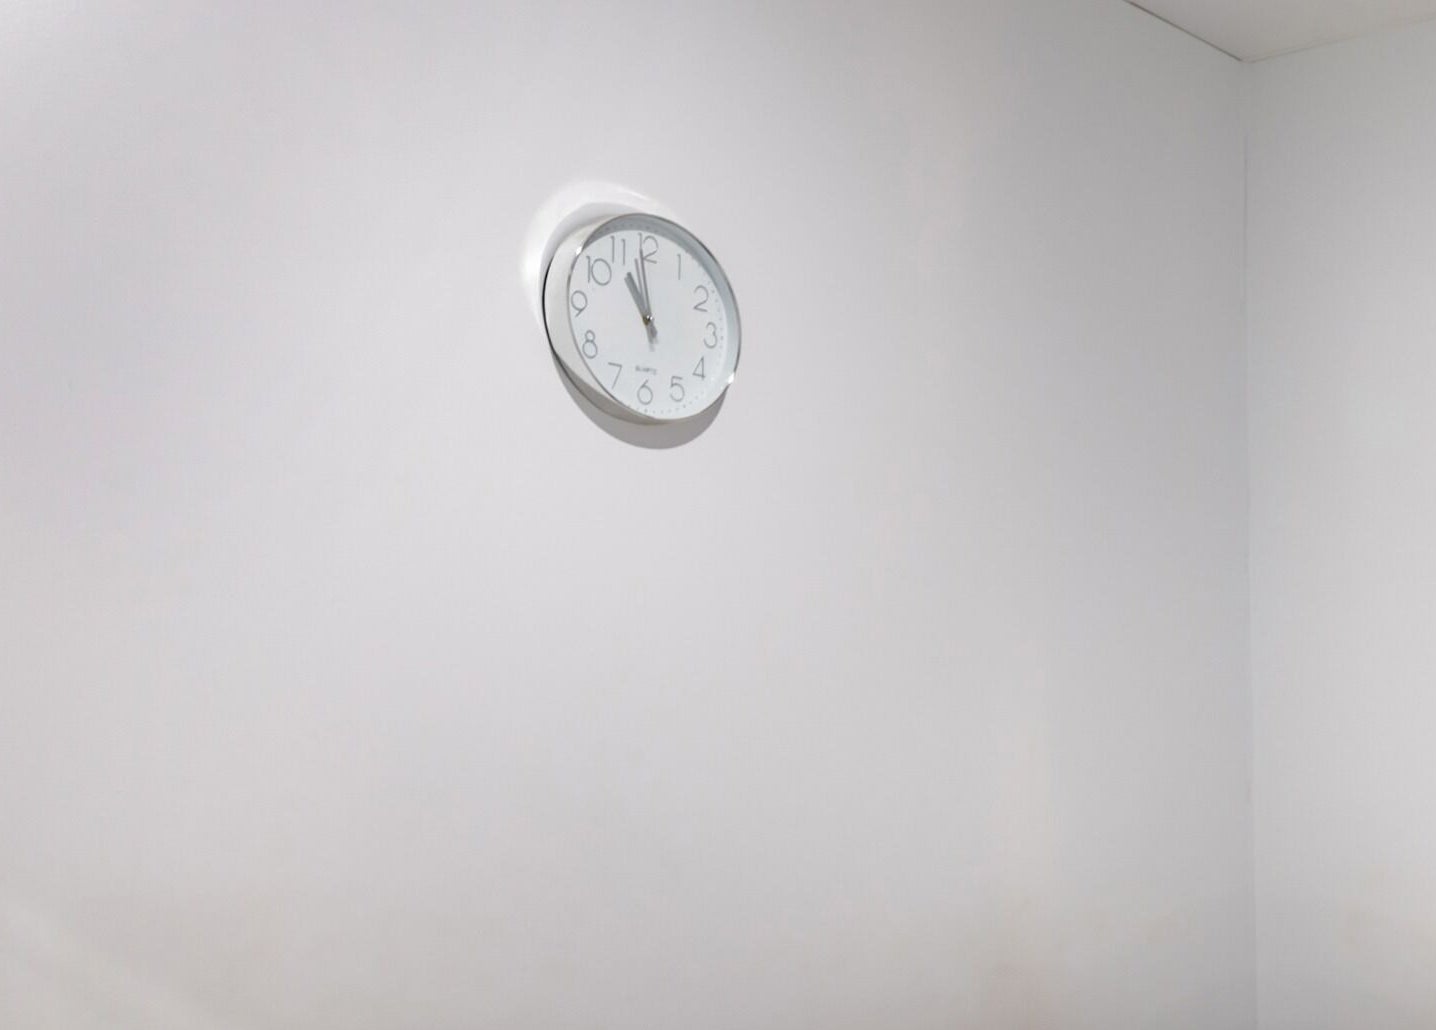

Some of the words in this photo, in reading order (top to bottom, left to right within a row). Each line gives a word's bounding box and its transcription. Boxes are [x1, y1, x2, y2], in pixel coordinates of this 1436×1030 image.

[610, 235, 627, 266] 11
[638, 232, 659, 265] 12
[586, 255, 613, 286] 10
[676, 253, 682, 281] 1
[571, 290, 588, 318] 9
[693, 285, 710, 313] 2
[582, 330, 598, 359] 8
[703, 322, 718, 349] 3
[608, 362, 623, 389] 7
[692, 356, 706, 381] 4
[637, 379, 653, 406] 6
[671, 376, 686, 402] 5
